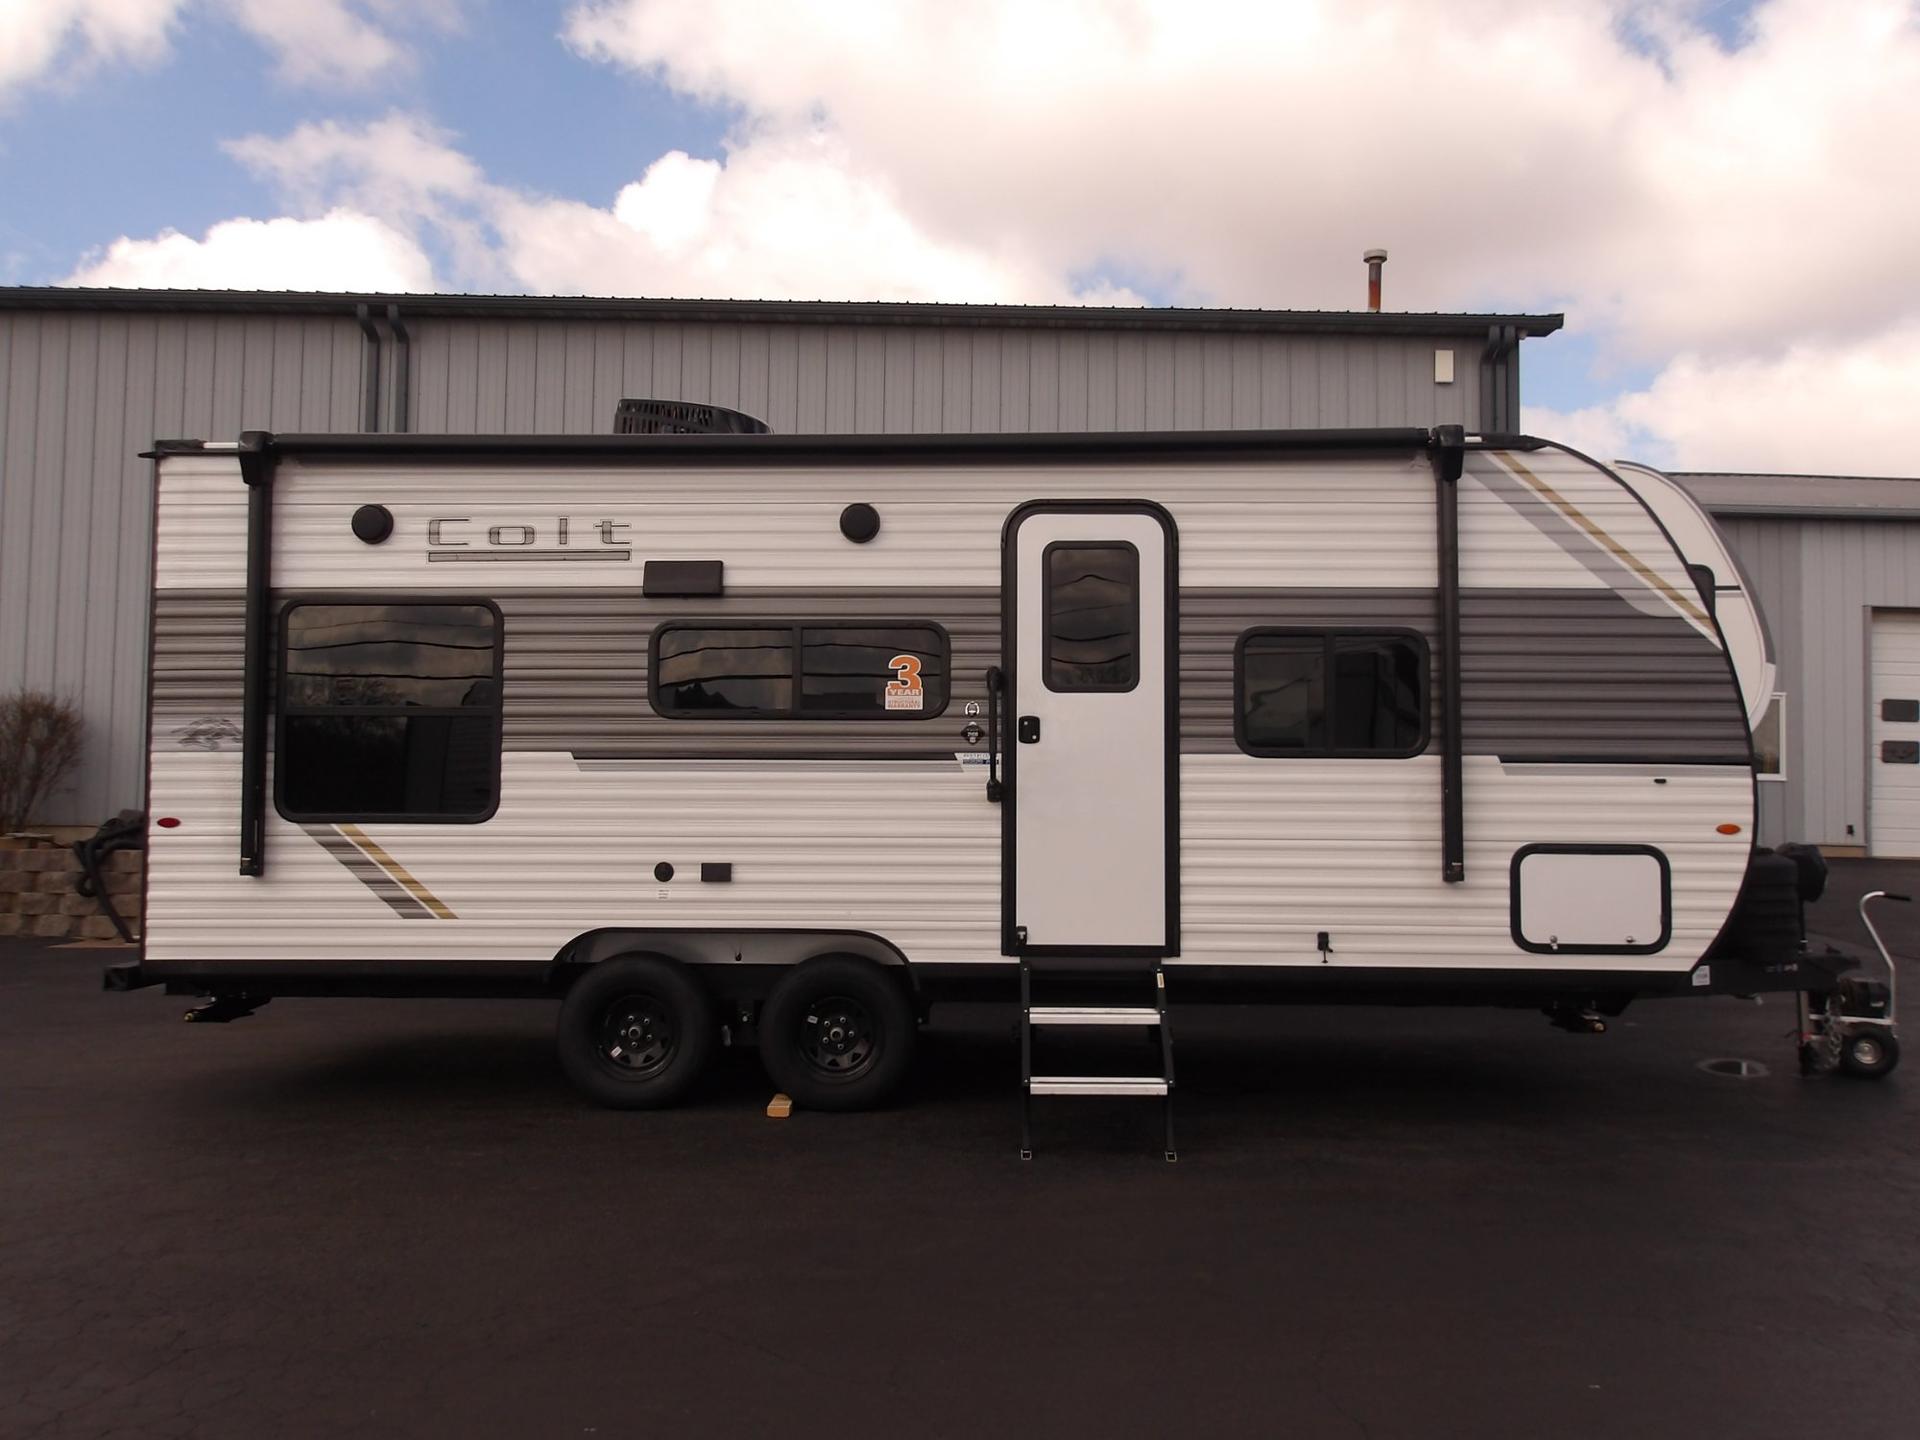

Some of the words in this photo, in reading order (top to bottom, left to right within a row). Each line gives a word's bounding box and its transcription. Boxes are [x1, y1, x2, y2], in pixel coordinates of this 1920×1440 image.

[428, 517, 631, 546] Colt
[888, 655, 921, 688] 3
[889, 688, 920, 696] YEAR
